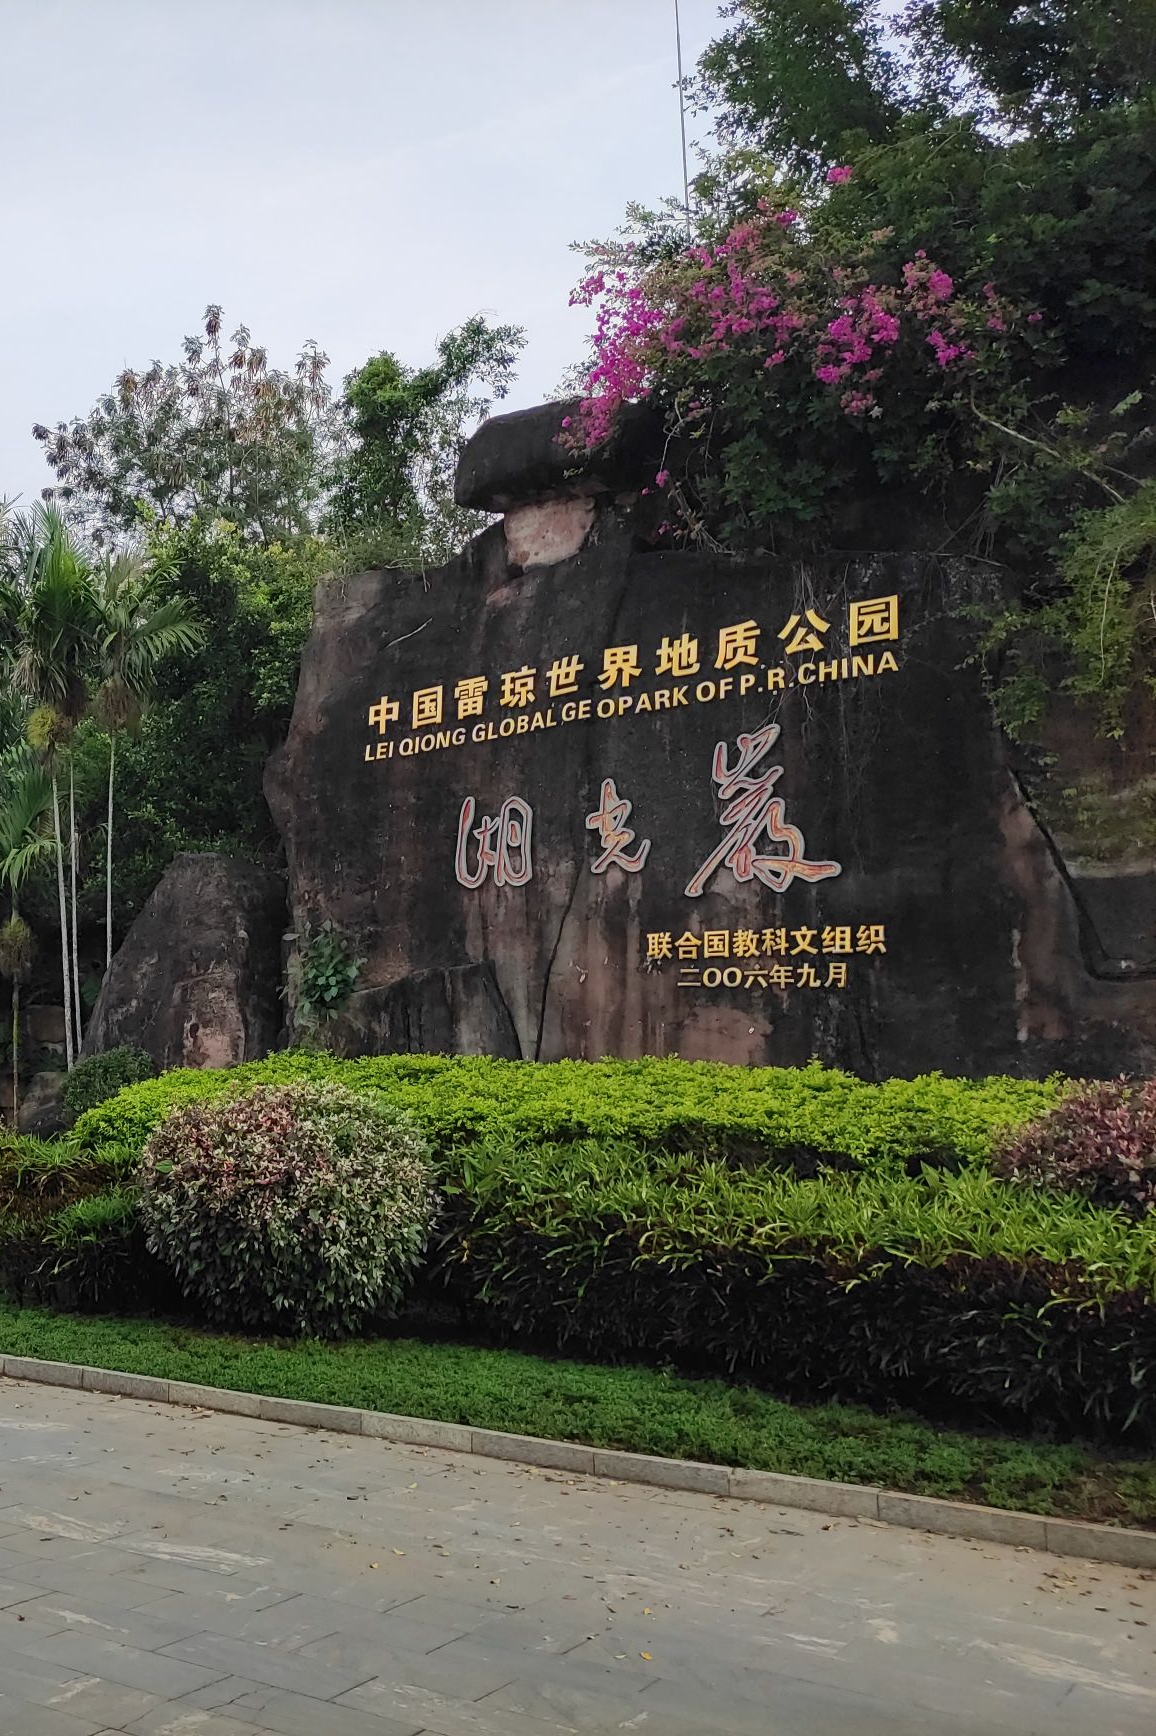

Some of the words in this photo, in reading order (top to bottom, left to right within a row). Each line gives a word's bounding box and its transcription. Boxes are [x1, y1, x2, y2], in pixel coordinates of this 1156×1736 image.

[368, 595, 899, 735] 中国雷琼世界地质公园
[364, 742, 394, 762] LEI
[399, 728, 466, 757] QIONG
[472, 707, 557, 744] GLOBAL
[696, 677, 733, 702] OF
[646, 925, 888, 960] 联合国教科文组织
